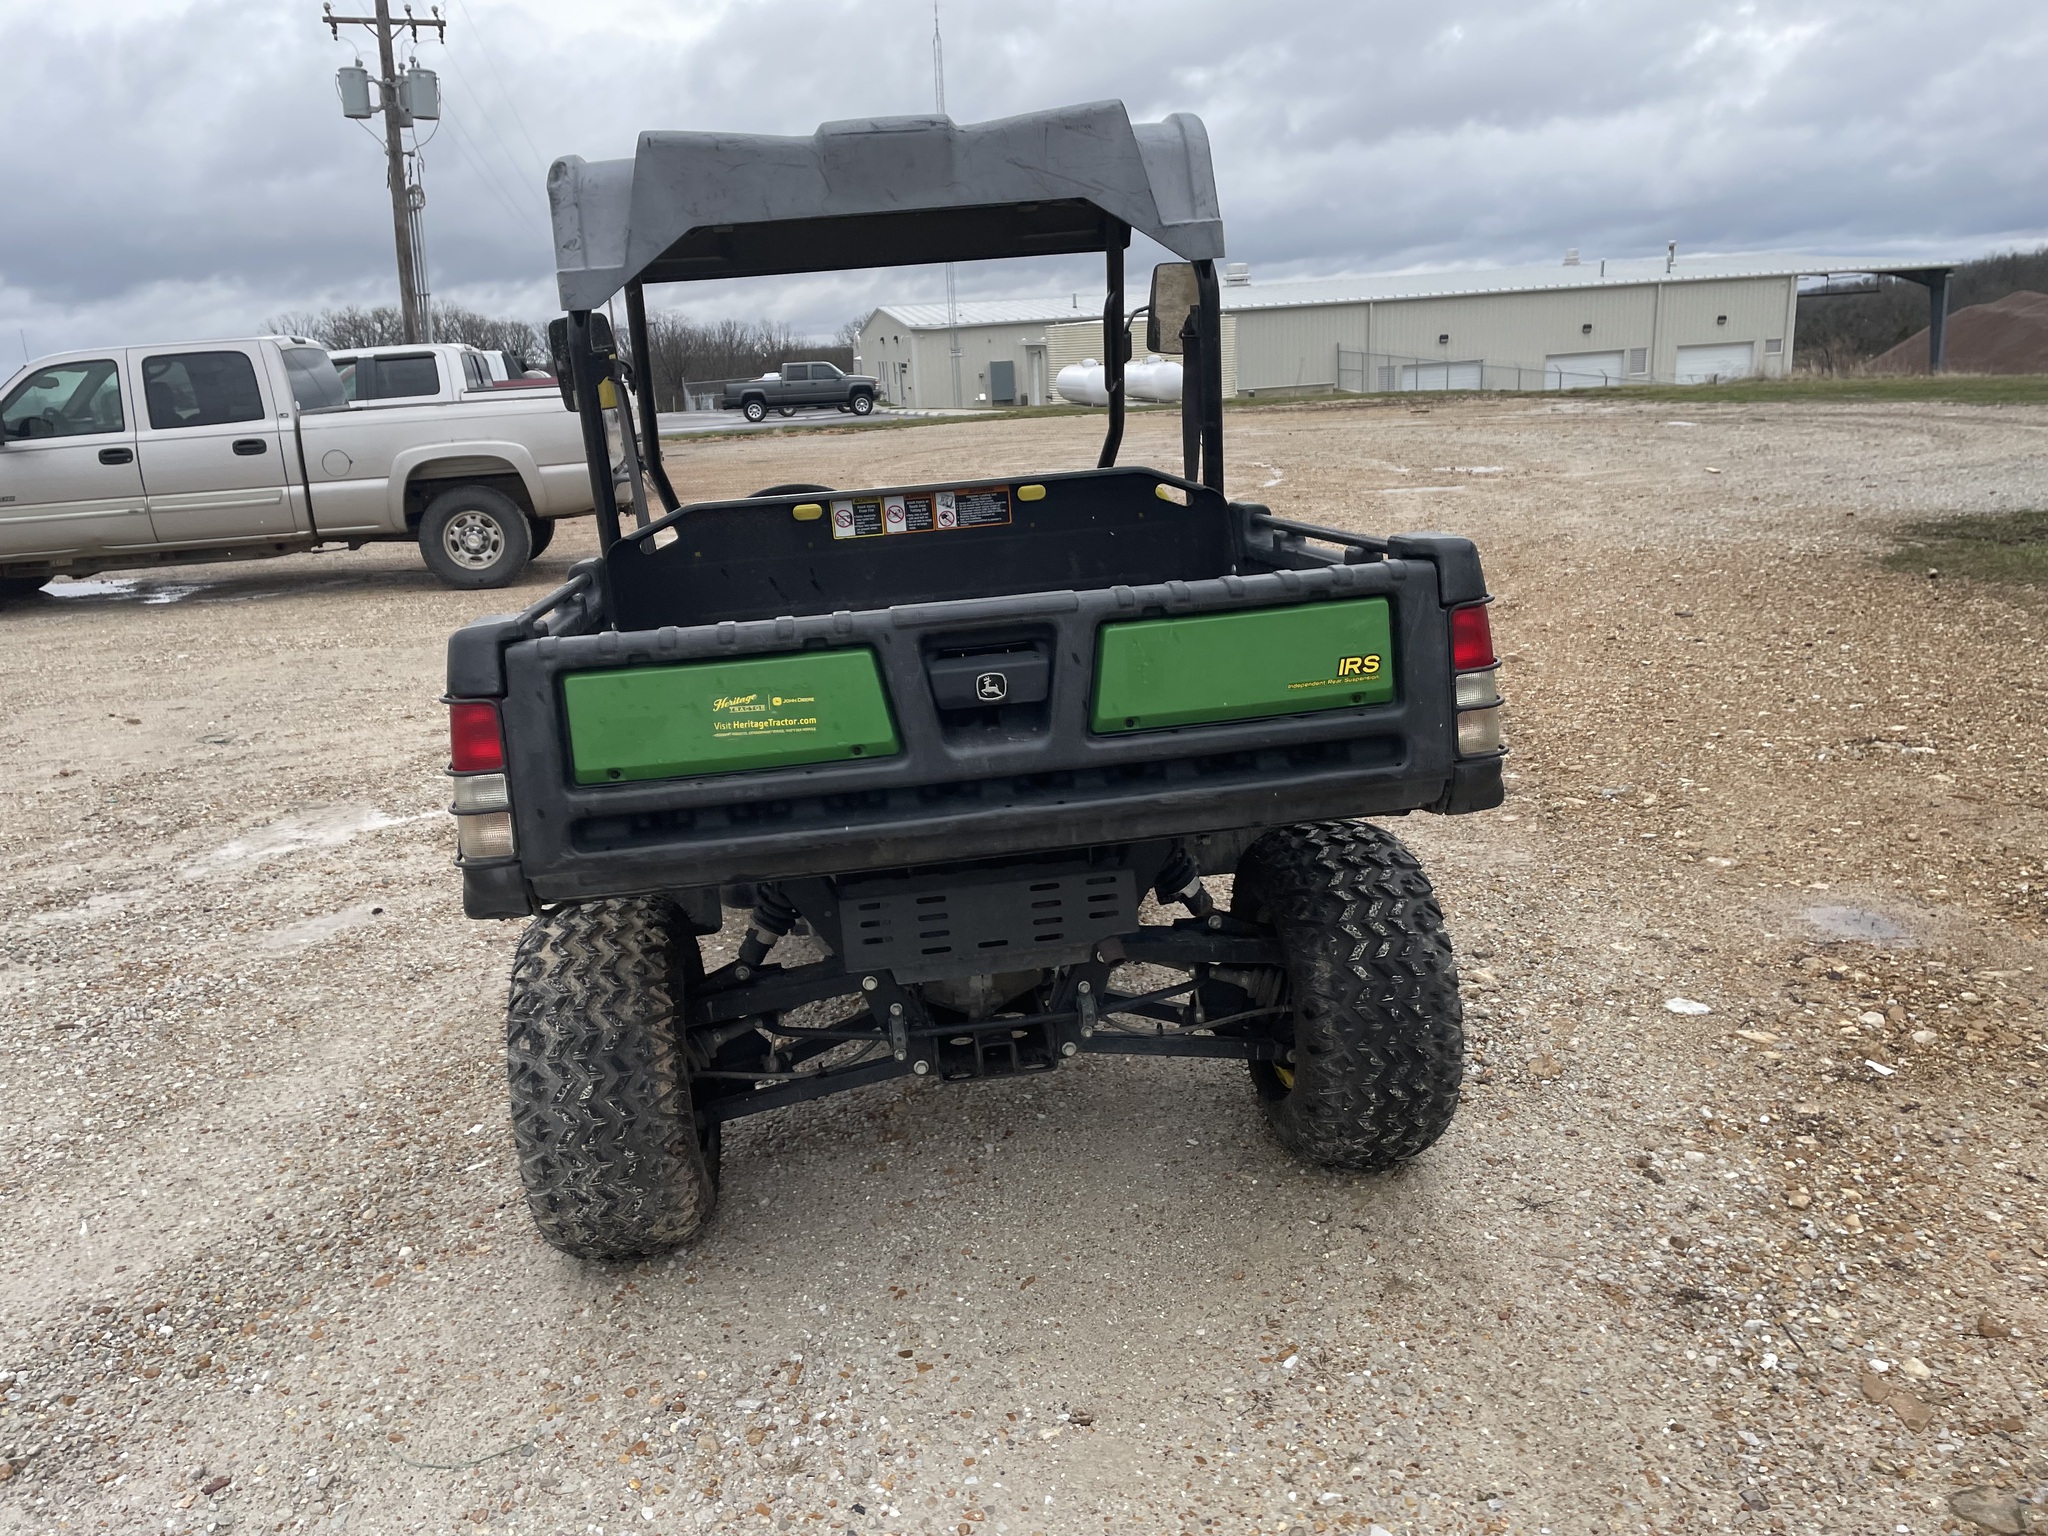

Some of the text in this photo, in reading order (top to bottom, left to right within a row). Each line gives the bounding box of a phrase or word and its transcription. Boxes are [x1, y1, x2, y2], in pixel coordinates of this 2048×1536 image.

[1338, 654, 1380, 676] IRS
[1287, 680, 1326, 689] Independent
[1344, 674, 1379, 683] Suspension
[713, 694, 757, 711] Heritage
[714, 717, 817, 730] Visit HeritageTractor.com
